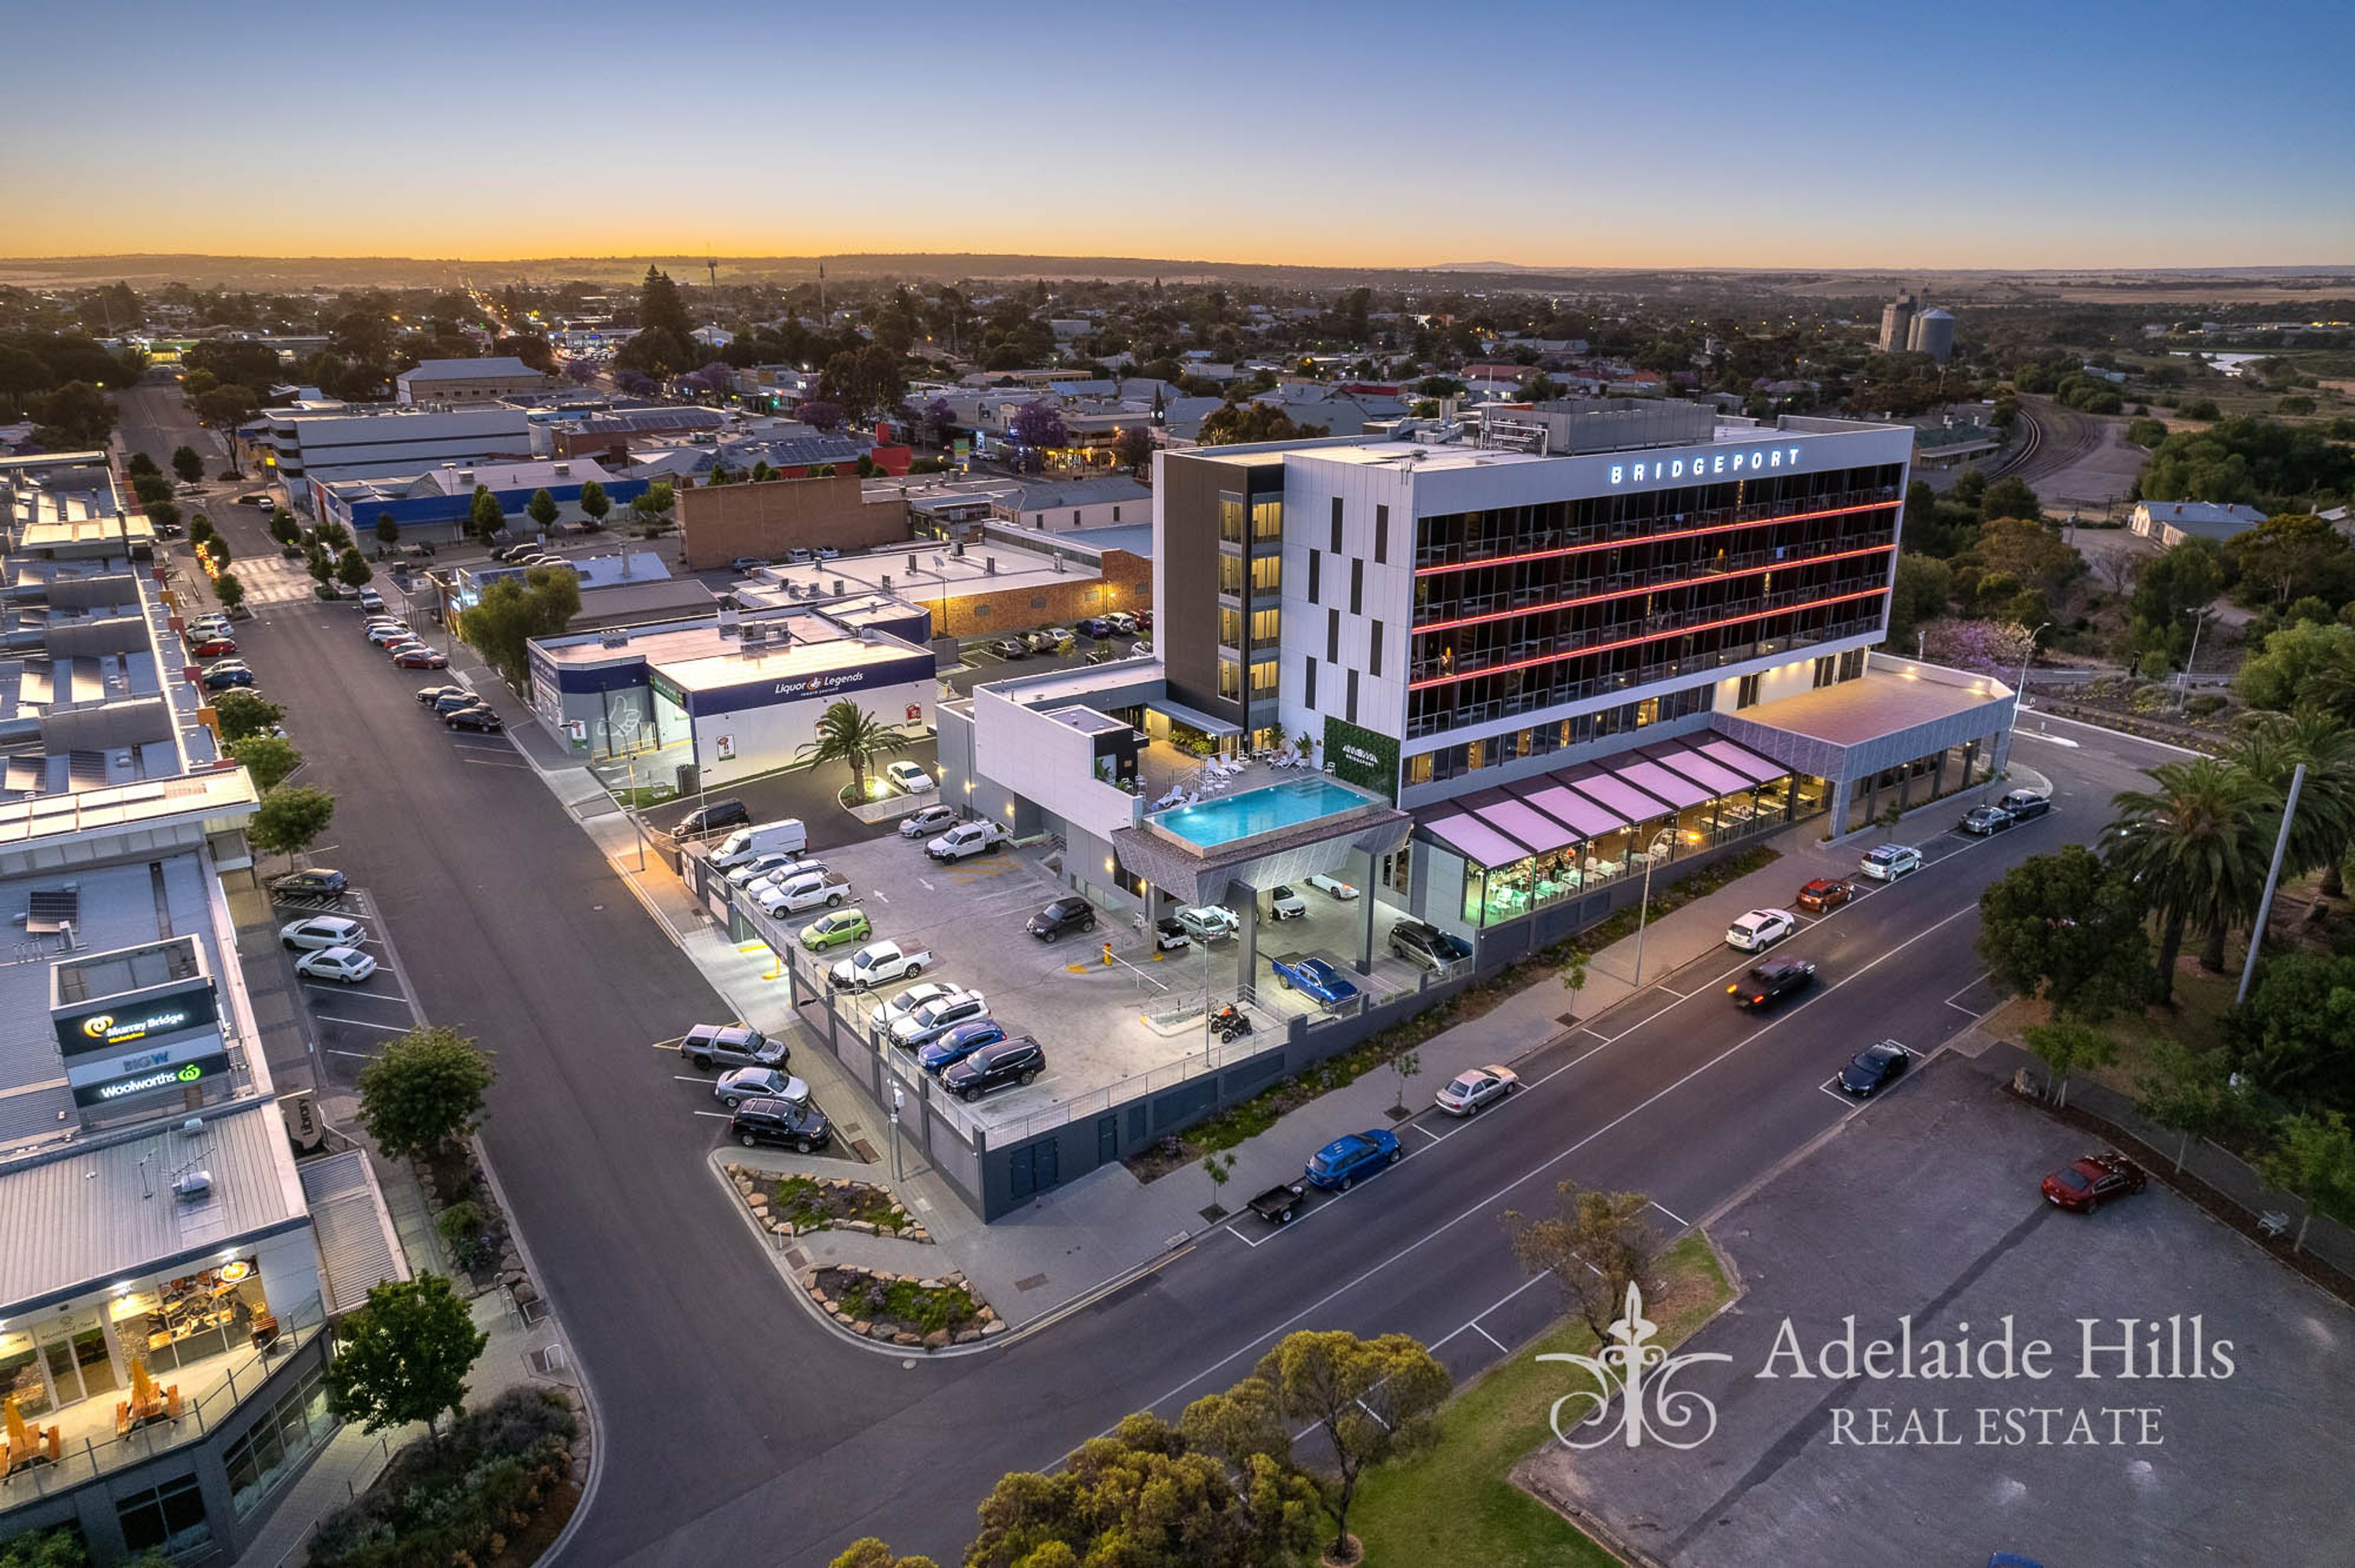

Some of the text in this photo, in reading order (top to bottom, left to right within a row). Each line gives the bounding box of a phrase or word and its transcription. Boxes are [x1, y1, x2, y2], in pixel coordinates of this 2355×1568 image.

[1611, 448, 1799, 484] BRIDGEPORT
[775, 672, 863, 695] Liquor Legends
[106, 1014, 184, 1037] Murray Bridge
[101, 1071, 177, 1098] Woolworths
[298, 1098, 314, 1135] Library
